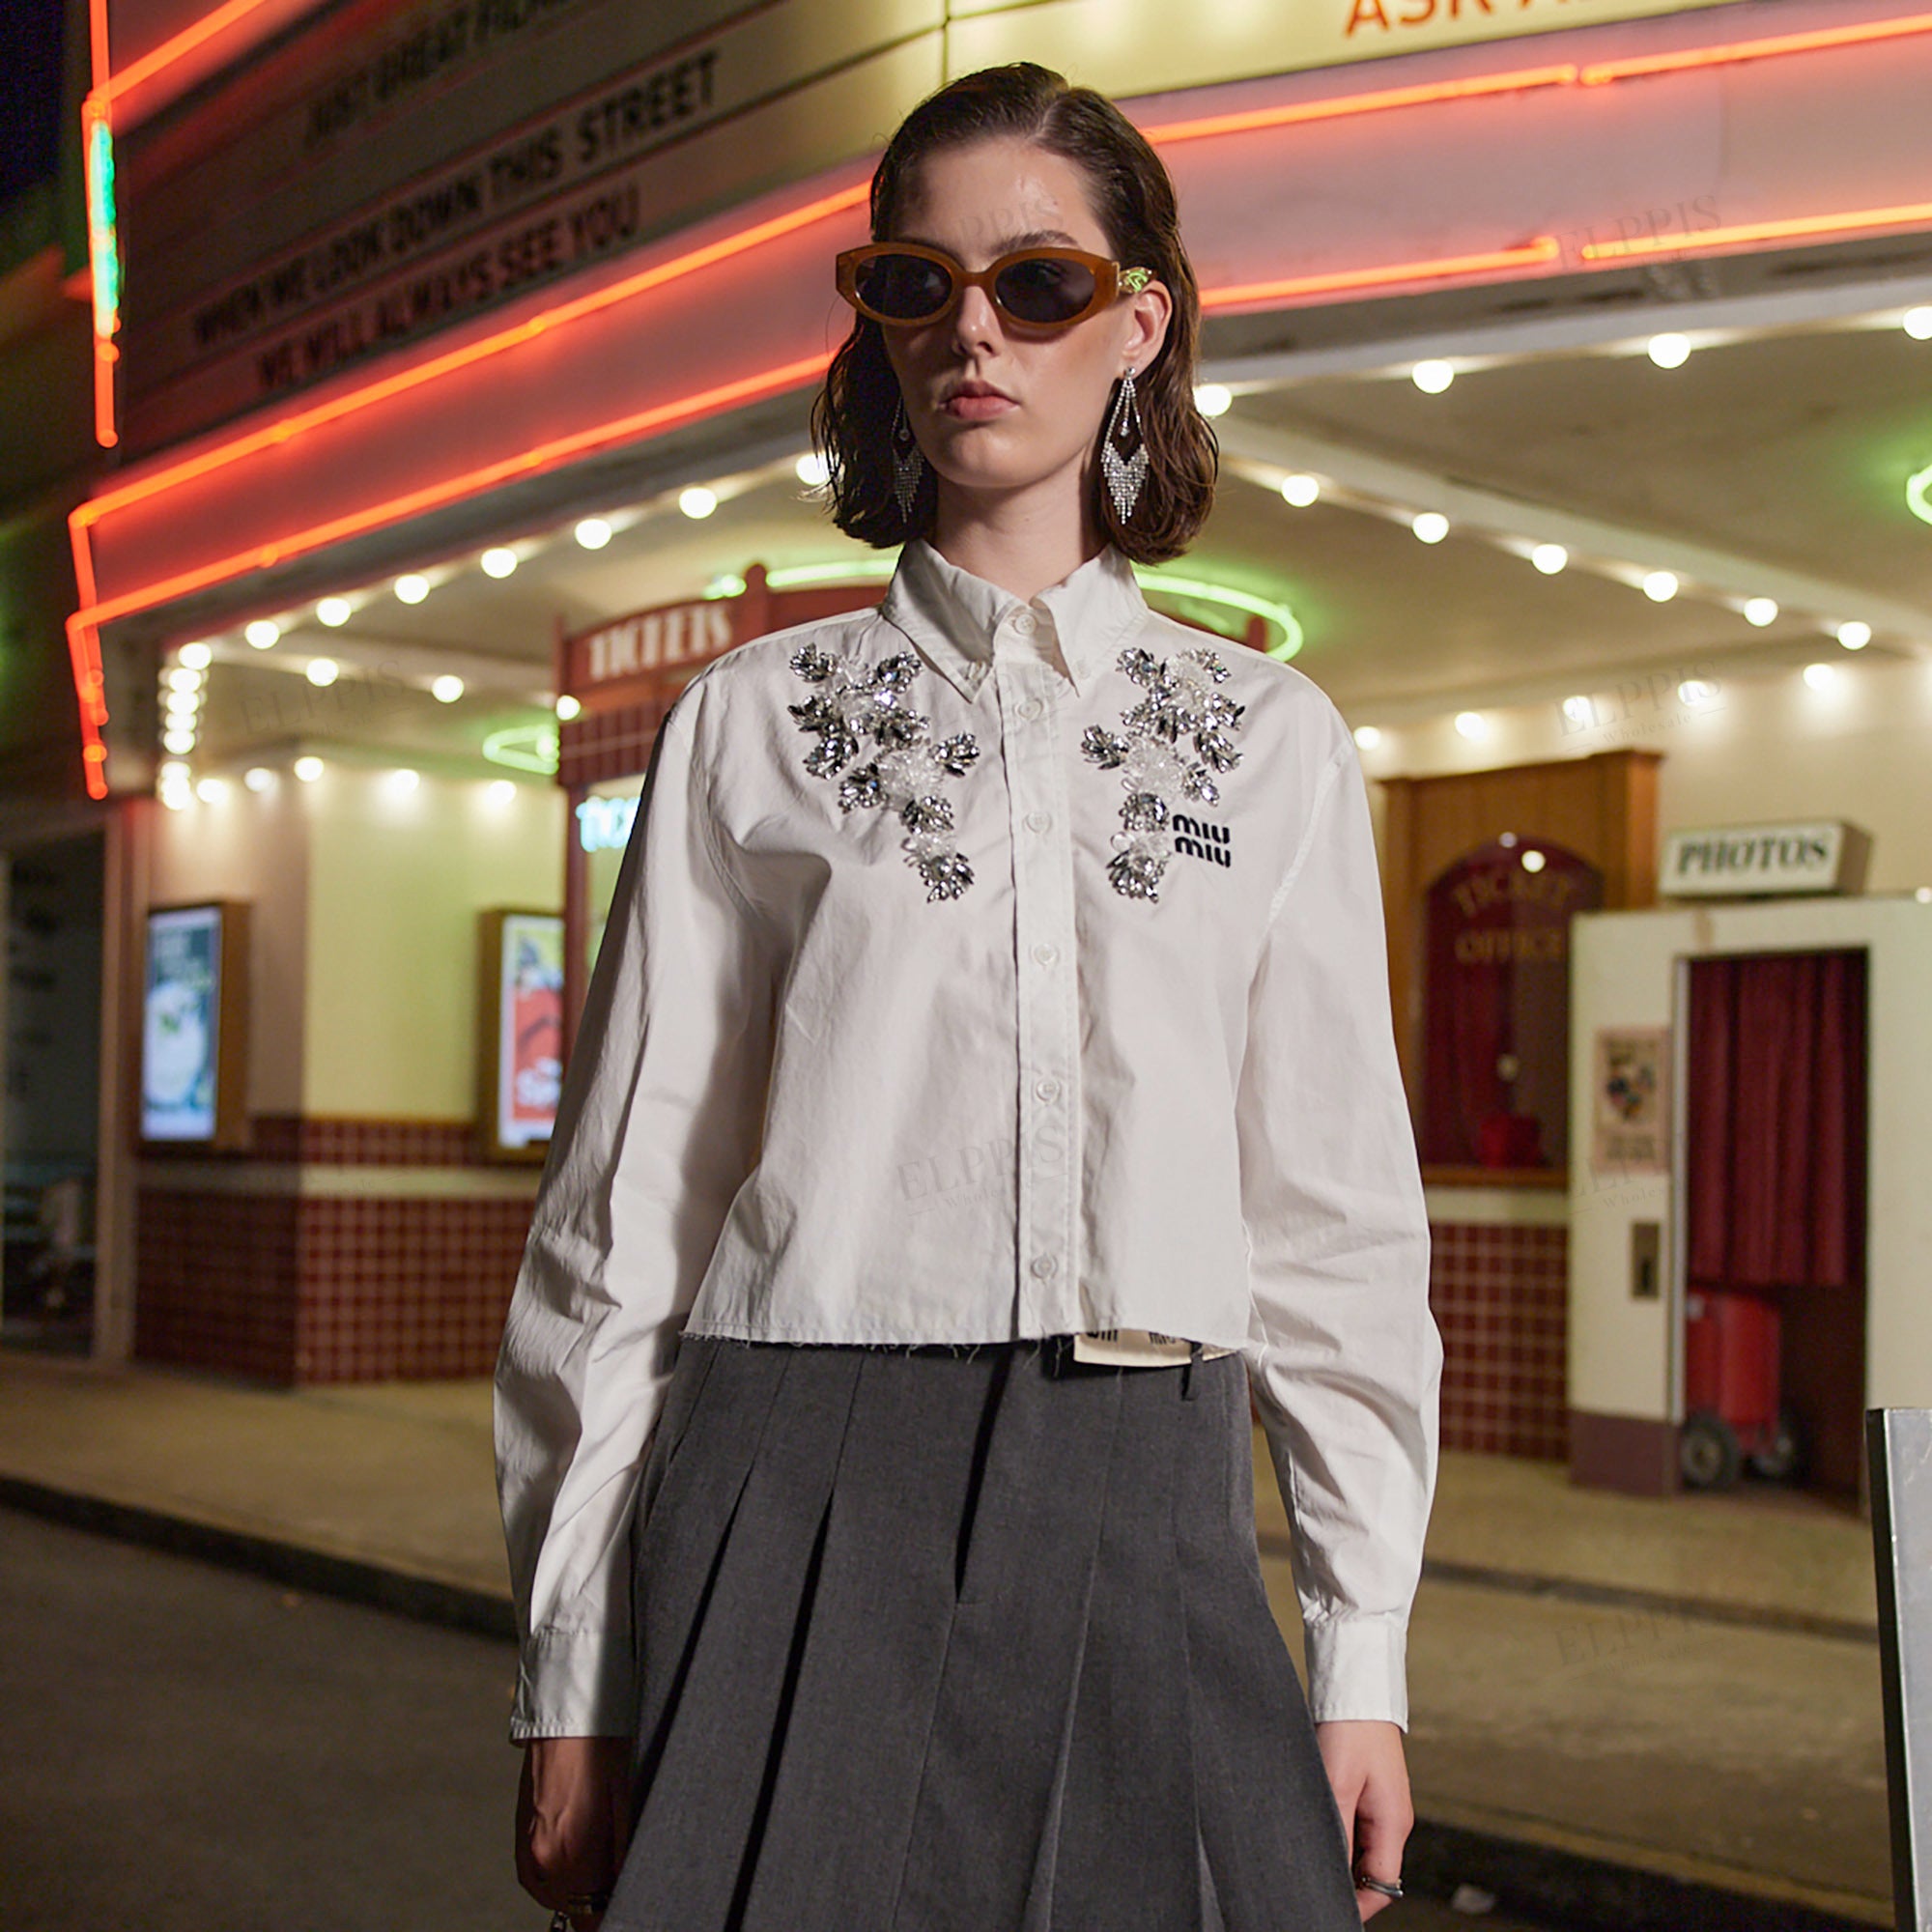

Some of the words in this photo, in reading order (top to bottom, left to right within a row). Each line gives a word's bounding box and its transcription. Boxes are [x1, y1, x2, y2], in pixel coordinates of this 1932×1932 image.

[576, 49, 720, 162] STREET
[570, 182, 640, 261] YOU
[1173, 814, 1230, 844] miu
[1175, 837, 1231, 867] miu
[1677, 834, 1831, 876] PHOTOS
